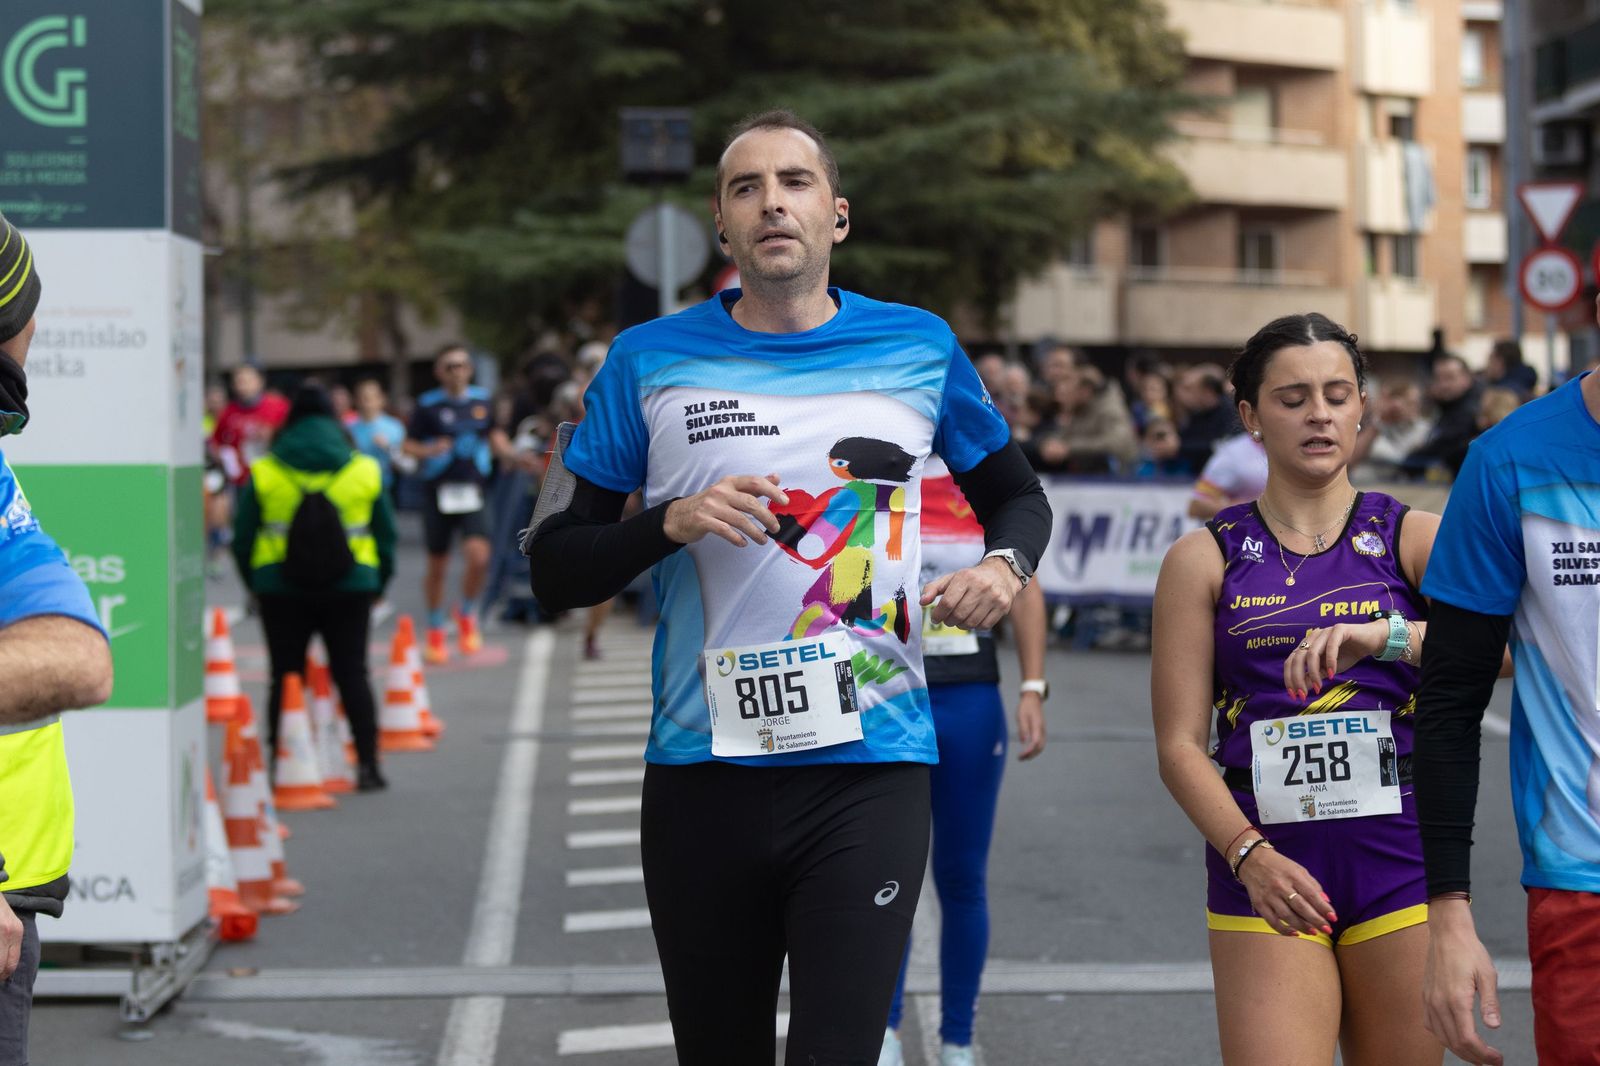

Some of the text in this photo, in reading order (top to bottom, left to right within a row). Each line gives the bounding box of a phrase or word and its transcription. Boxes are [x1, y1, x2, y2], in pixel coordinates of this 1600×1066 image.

[684, 400, 739, 417] XLI SAN
[686, 412, 756, 430] SILVESTRE
[688, 425, 781, 445] SALMANTINA
[1551, 542, 1574, 554] XLI
[1230, 593, 1287, 610] Jamón
[1320, 600, 1379, 617] PRIM
[1246, 635, 1296, 650] Atletismo
[739, 643, 836, 671] SETEL
[735, 670, 809, 720] 805
[760, 716, 791, 728] JORGE
[1288, 718, 1378, 740] SETEL
[776, 730, 817, 743] Ayuntamiento
[786, 739, 818, 750] Salamanca
[1282, 741, 1351, 786] 258
[1309, 784, 1328, 794] ANA
[1318, 799, 1358, 809] Ayuntamiento
[1327, 807, 1359, 816] Salamanca
